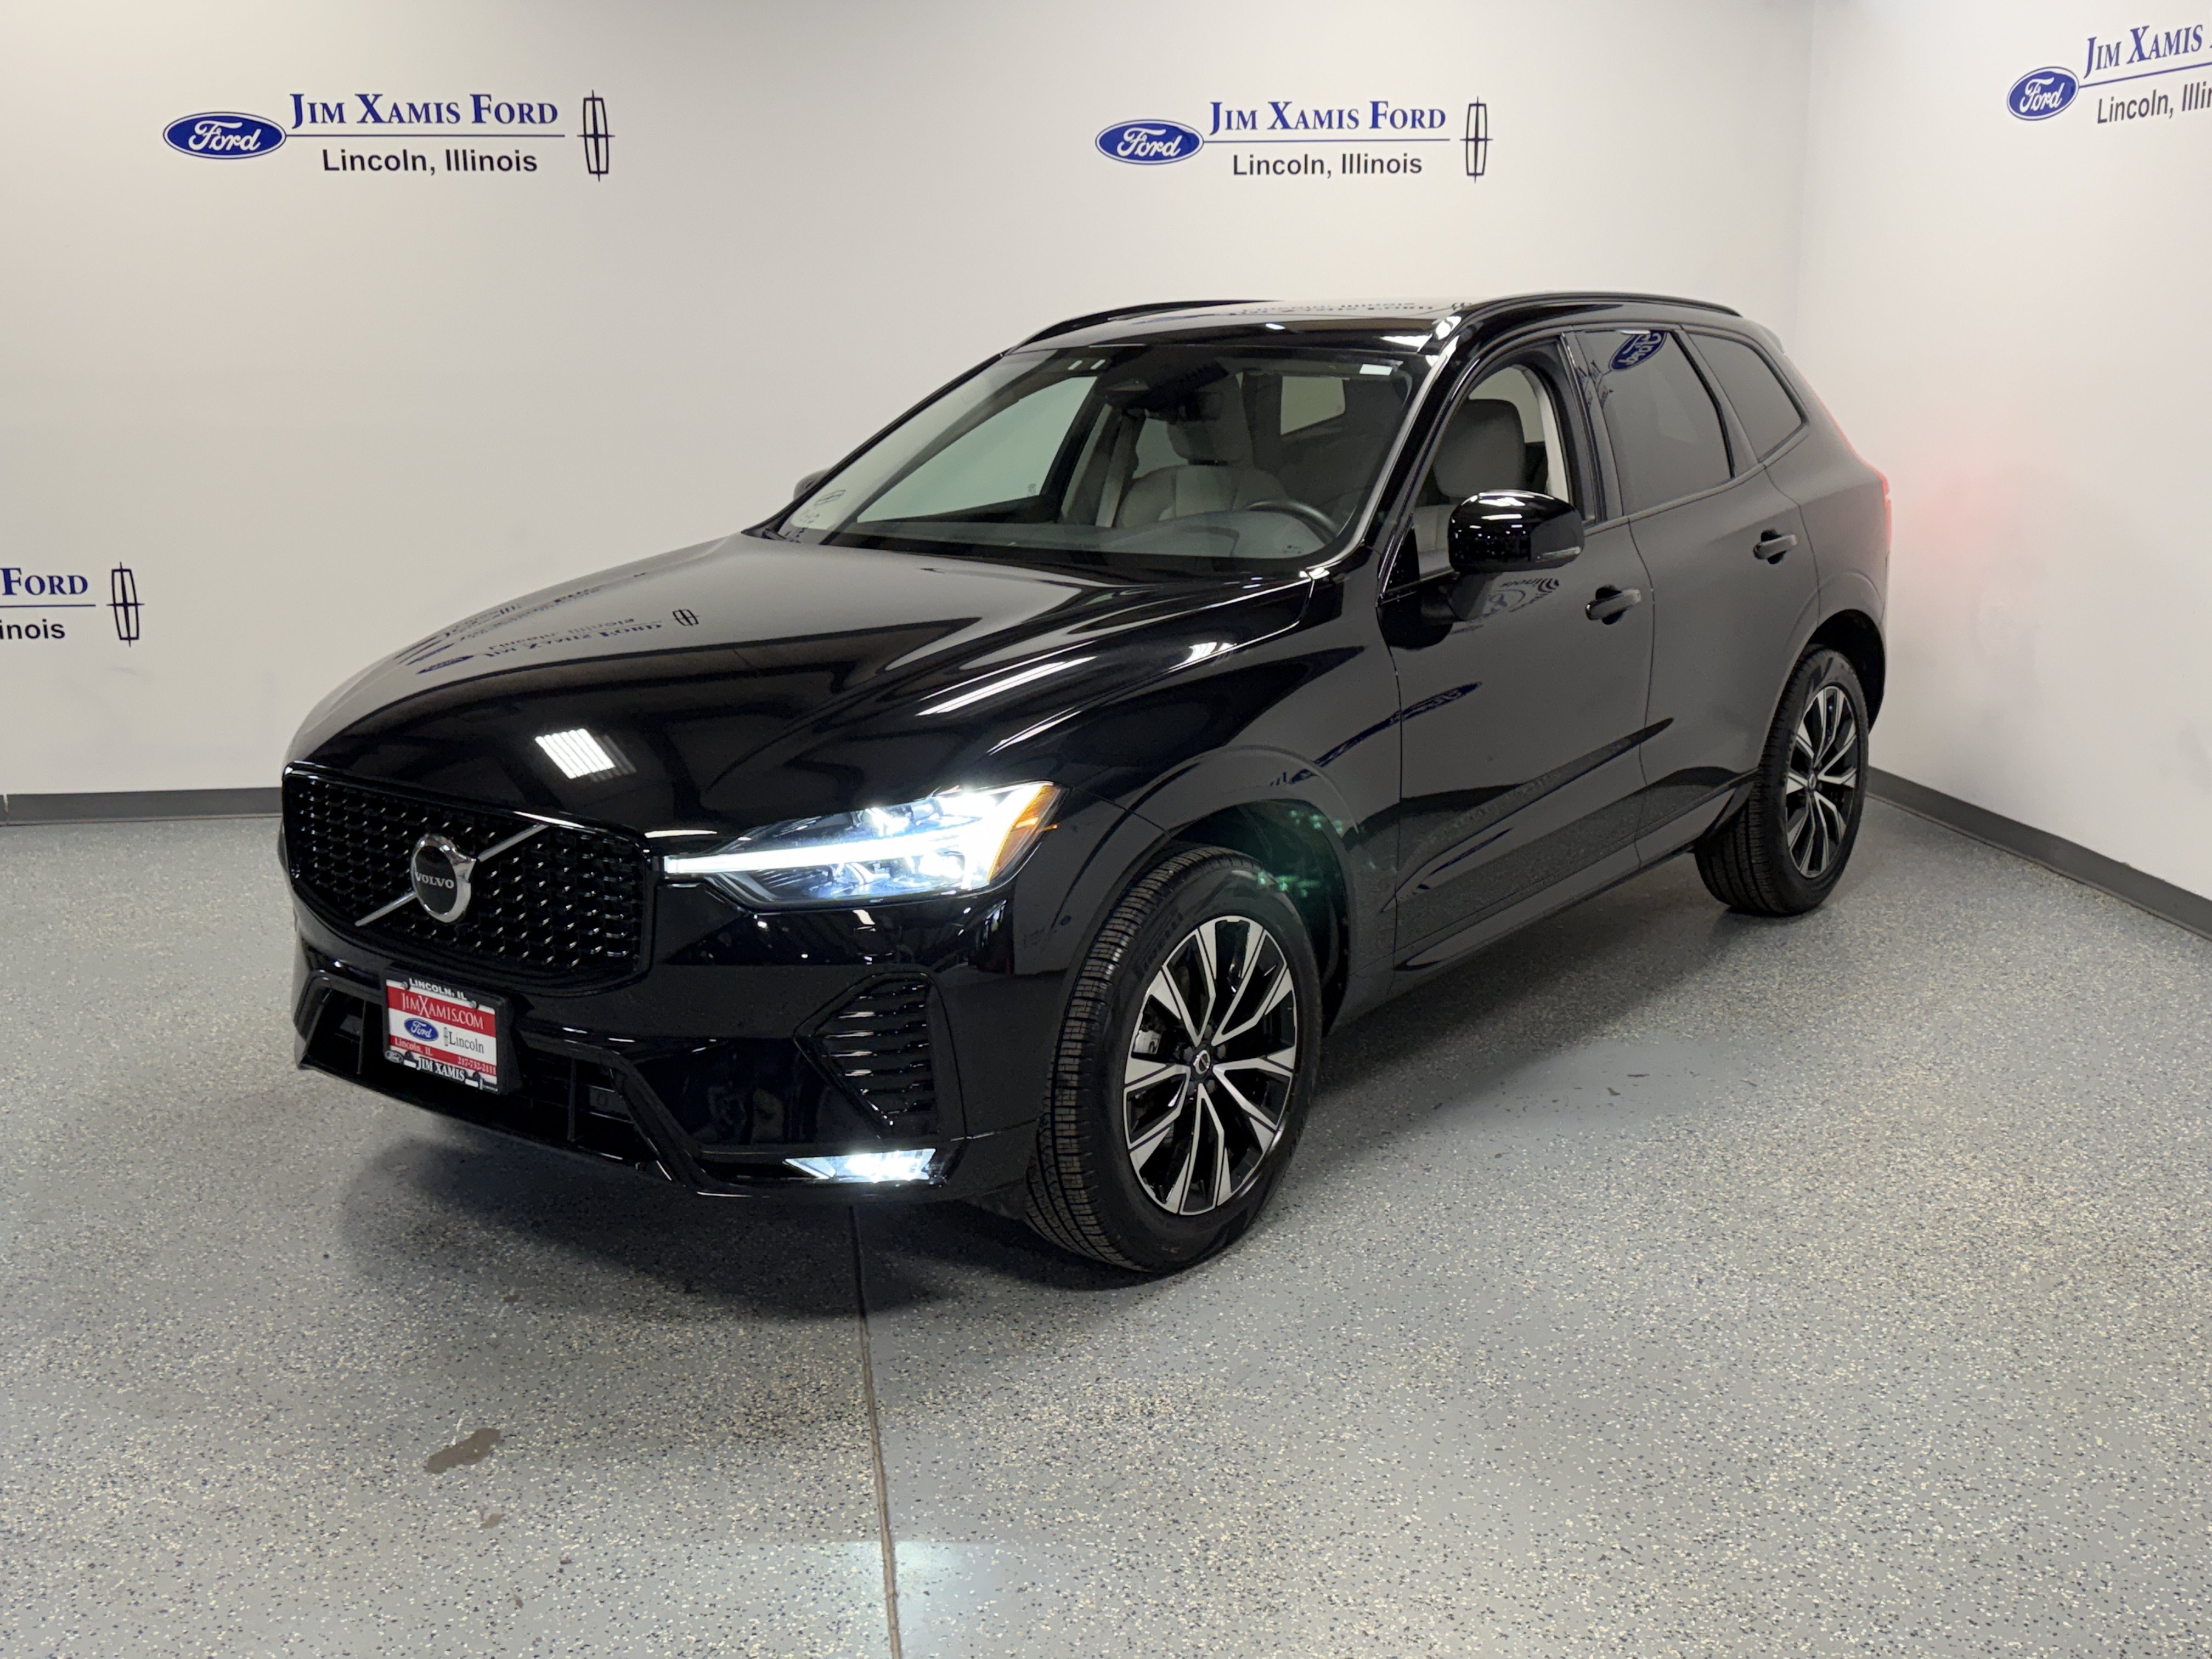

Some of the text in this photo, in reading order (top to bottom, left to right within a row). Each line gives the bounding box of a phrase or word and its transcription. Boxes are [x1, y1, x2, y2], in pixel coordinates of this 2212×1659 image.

[2083, 25, 2203, 79] JIM XAMIS
[2019, 77, 2065, 113] Ford
[2097, 89, 2174, 124] Lincoln,
[290, 93, 558, 129] JIM XAMIS FORD
[1209, 100, 1446, 136] JIM XAMIS FORD
[189, 120, 261, 151] Ford
[1117, 127, 1182, 157] Ford
[323, 149, 538, 176] Lincoln, Illinois
[1233, 153, 1423, 179] Lincoln, Illinois
[415, 871, 455, 889] VOLVO
[409, 978, 467, 1000] LINCOLN, IL
[410, 1022, 433, 1039] Ford
[449, 1031, 484, 1054] Lincoln
[433, 1062, 465, 1082] XAMIS
